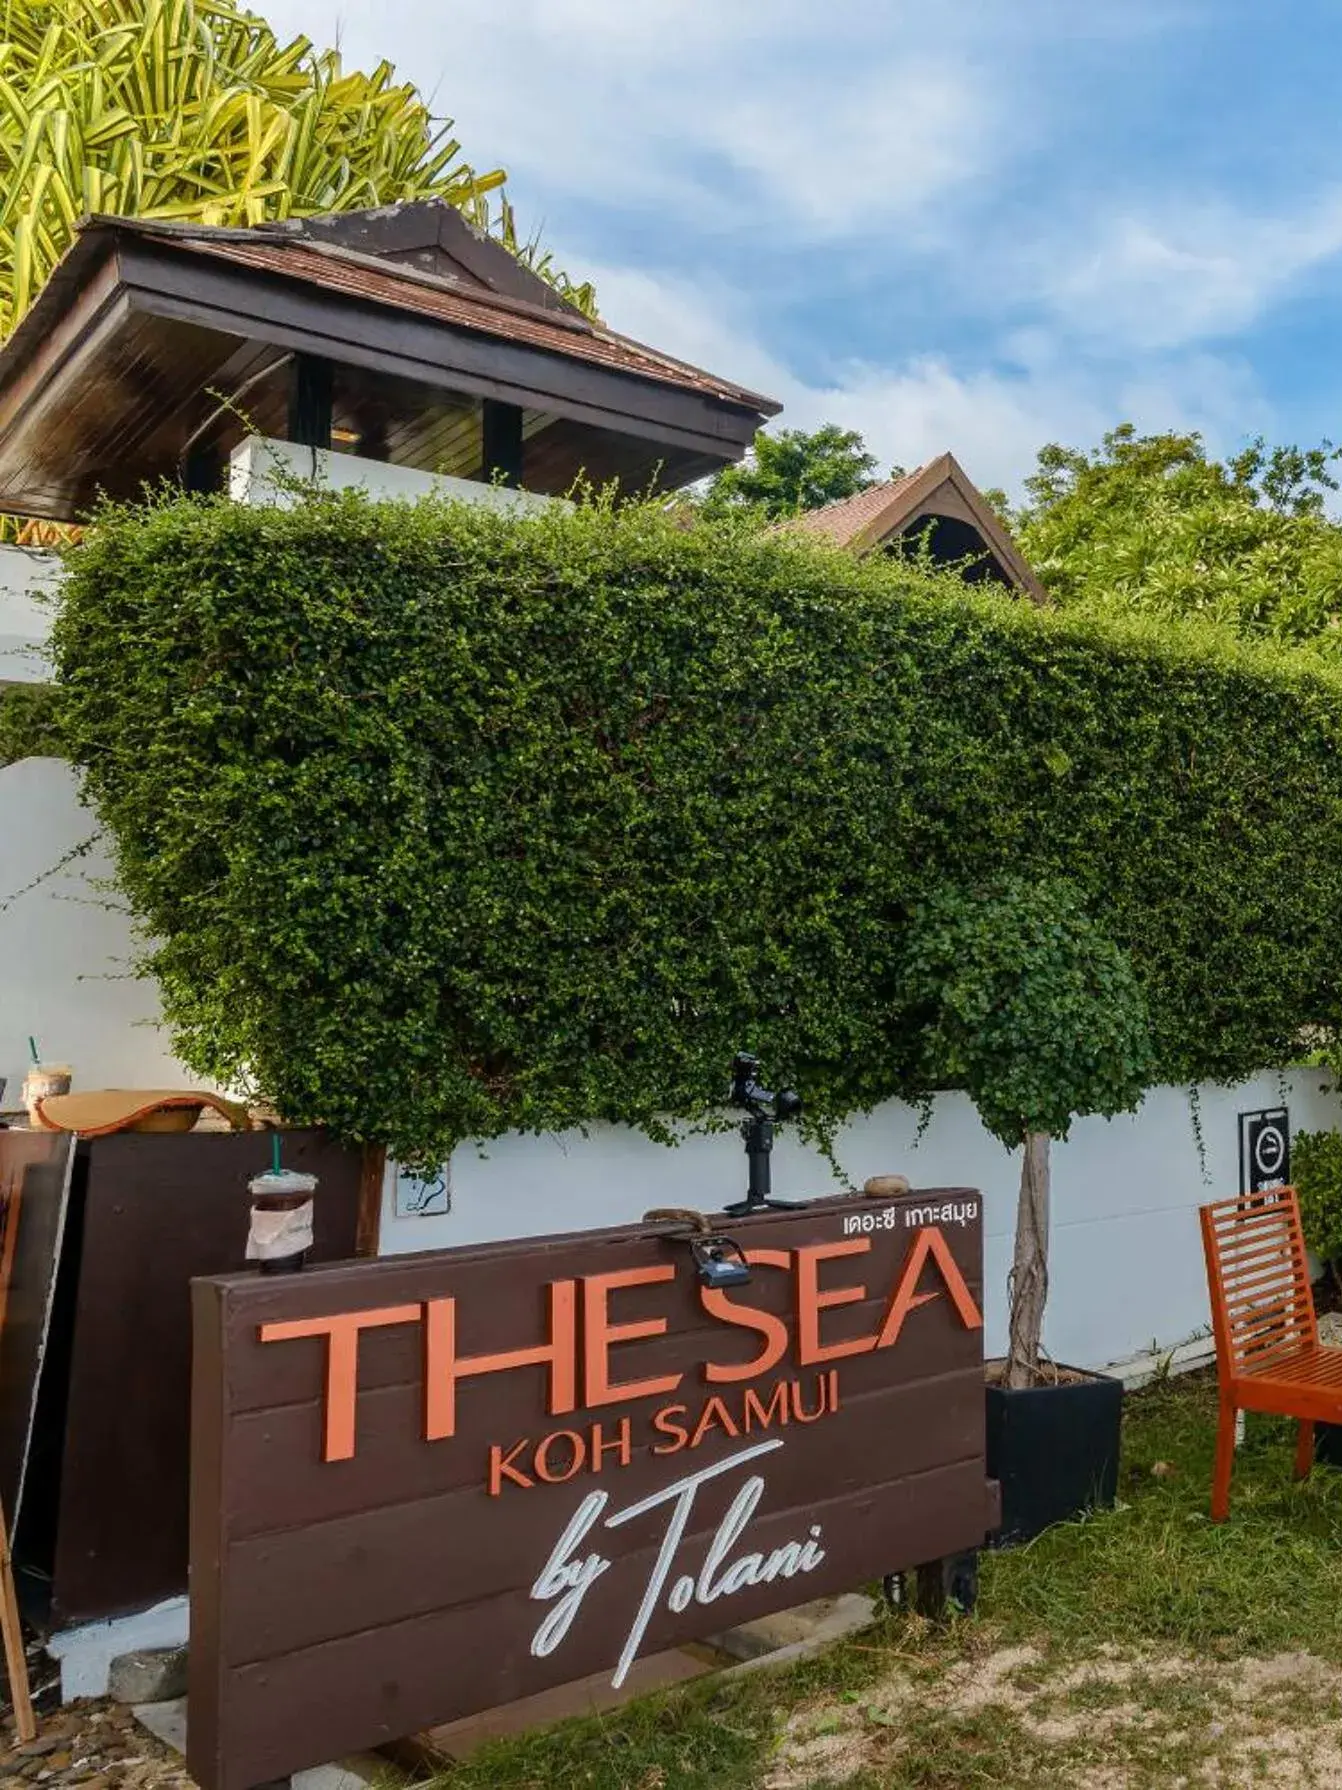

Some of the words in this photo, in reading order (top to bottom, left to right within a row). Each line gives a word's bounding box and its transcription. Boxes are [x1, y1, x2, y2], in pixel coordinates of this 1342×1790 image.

[843, 1206, 896, 1235] เดอะซี
[905, 1201, 978, 1228] เกาะสมุย
[486, 1416, 632, 1497] KOH
[650, 1368, 840, 1456] SAMUI
[530, 1489, 609, 1658] by
[604, 1437, 827, 1690] Tolani
